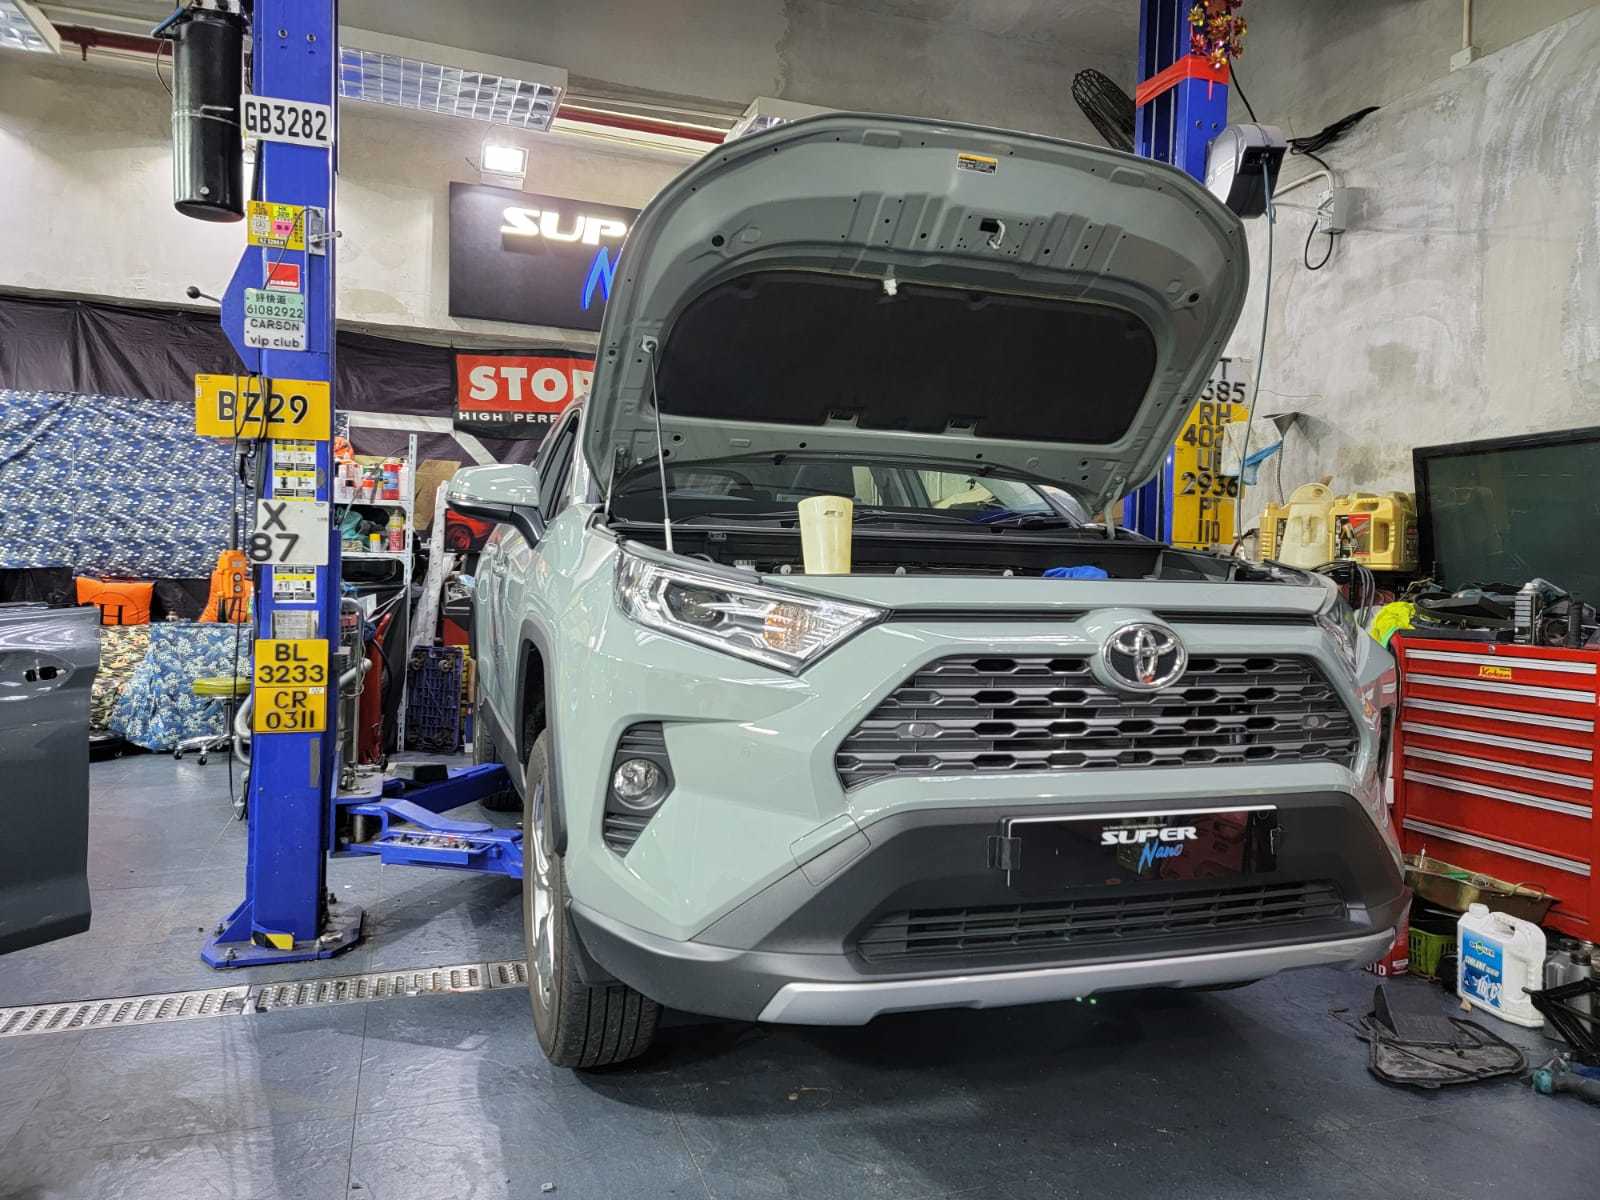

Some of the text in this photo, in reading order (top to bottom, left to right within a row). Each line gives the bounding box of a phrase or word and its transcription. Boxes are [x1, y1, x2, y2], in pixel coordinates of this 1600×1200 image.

[244, 101, 328, 141] GB3282
[246, 304, 304, 319] 61082922
[250, 318, 300, 331] CARSON
[250, 334, 300, 348] vip club
[218, 390, 308, 424] BZ29
[459, 411, 504, 423] HIGH
[262, 502, 287, 532] X
[250, 532, 300, 562] 87
[275, 643, 309, 662] BL
[258, 664, 324, 684] 3233
[274, 690, 308, 709] CR
[265, 710, 315, 729] 0311
[1100, 826, 1199, 846] SUPER
[1137, 838, 1184, 875] Nano
